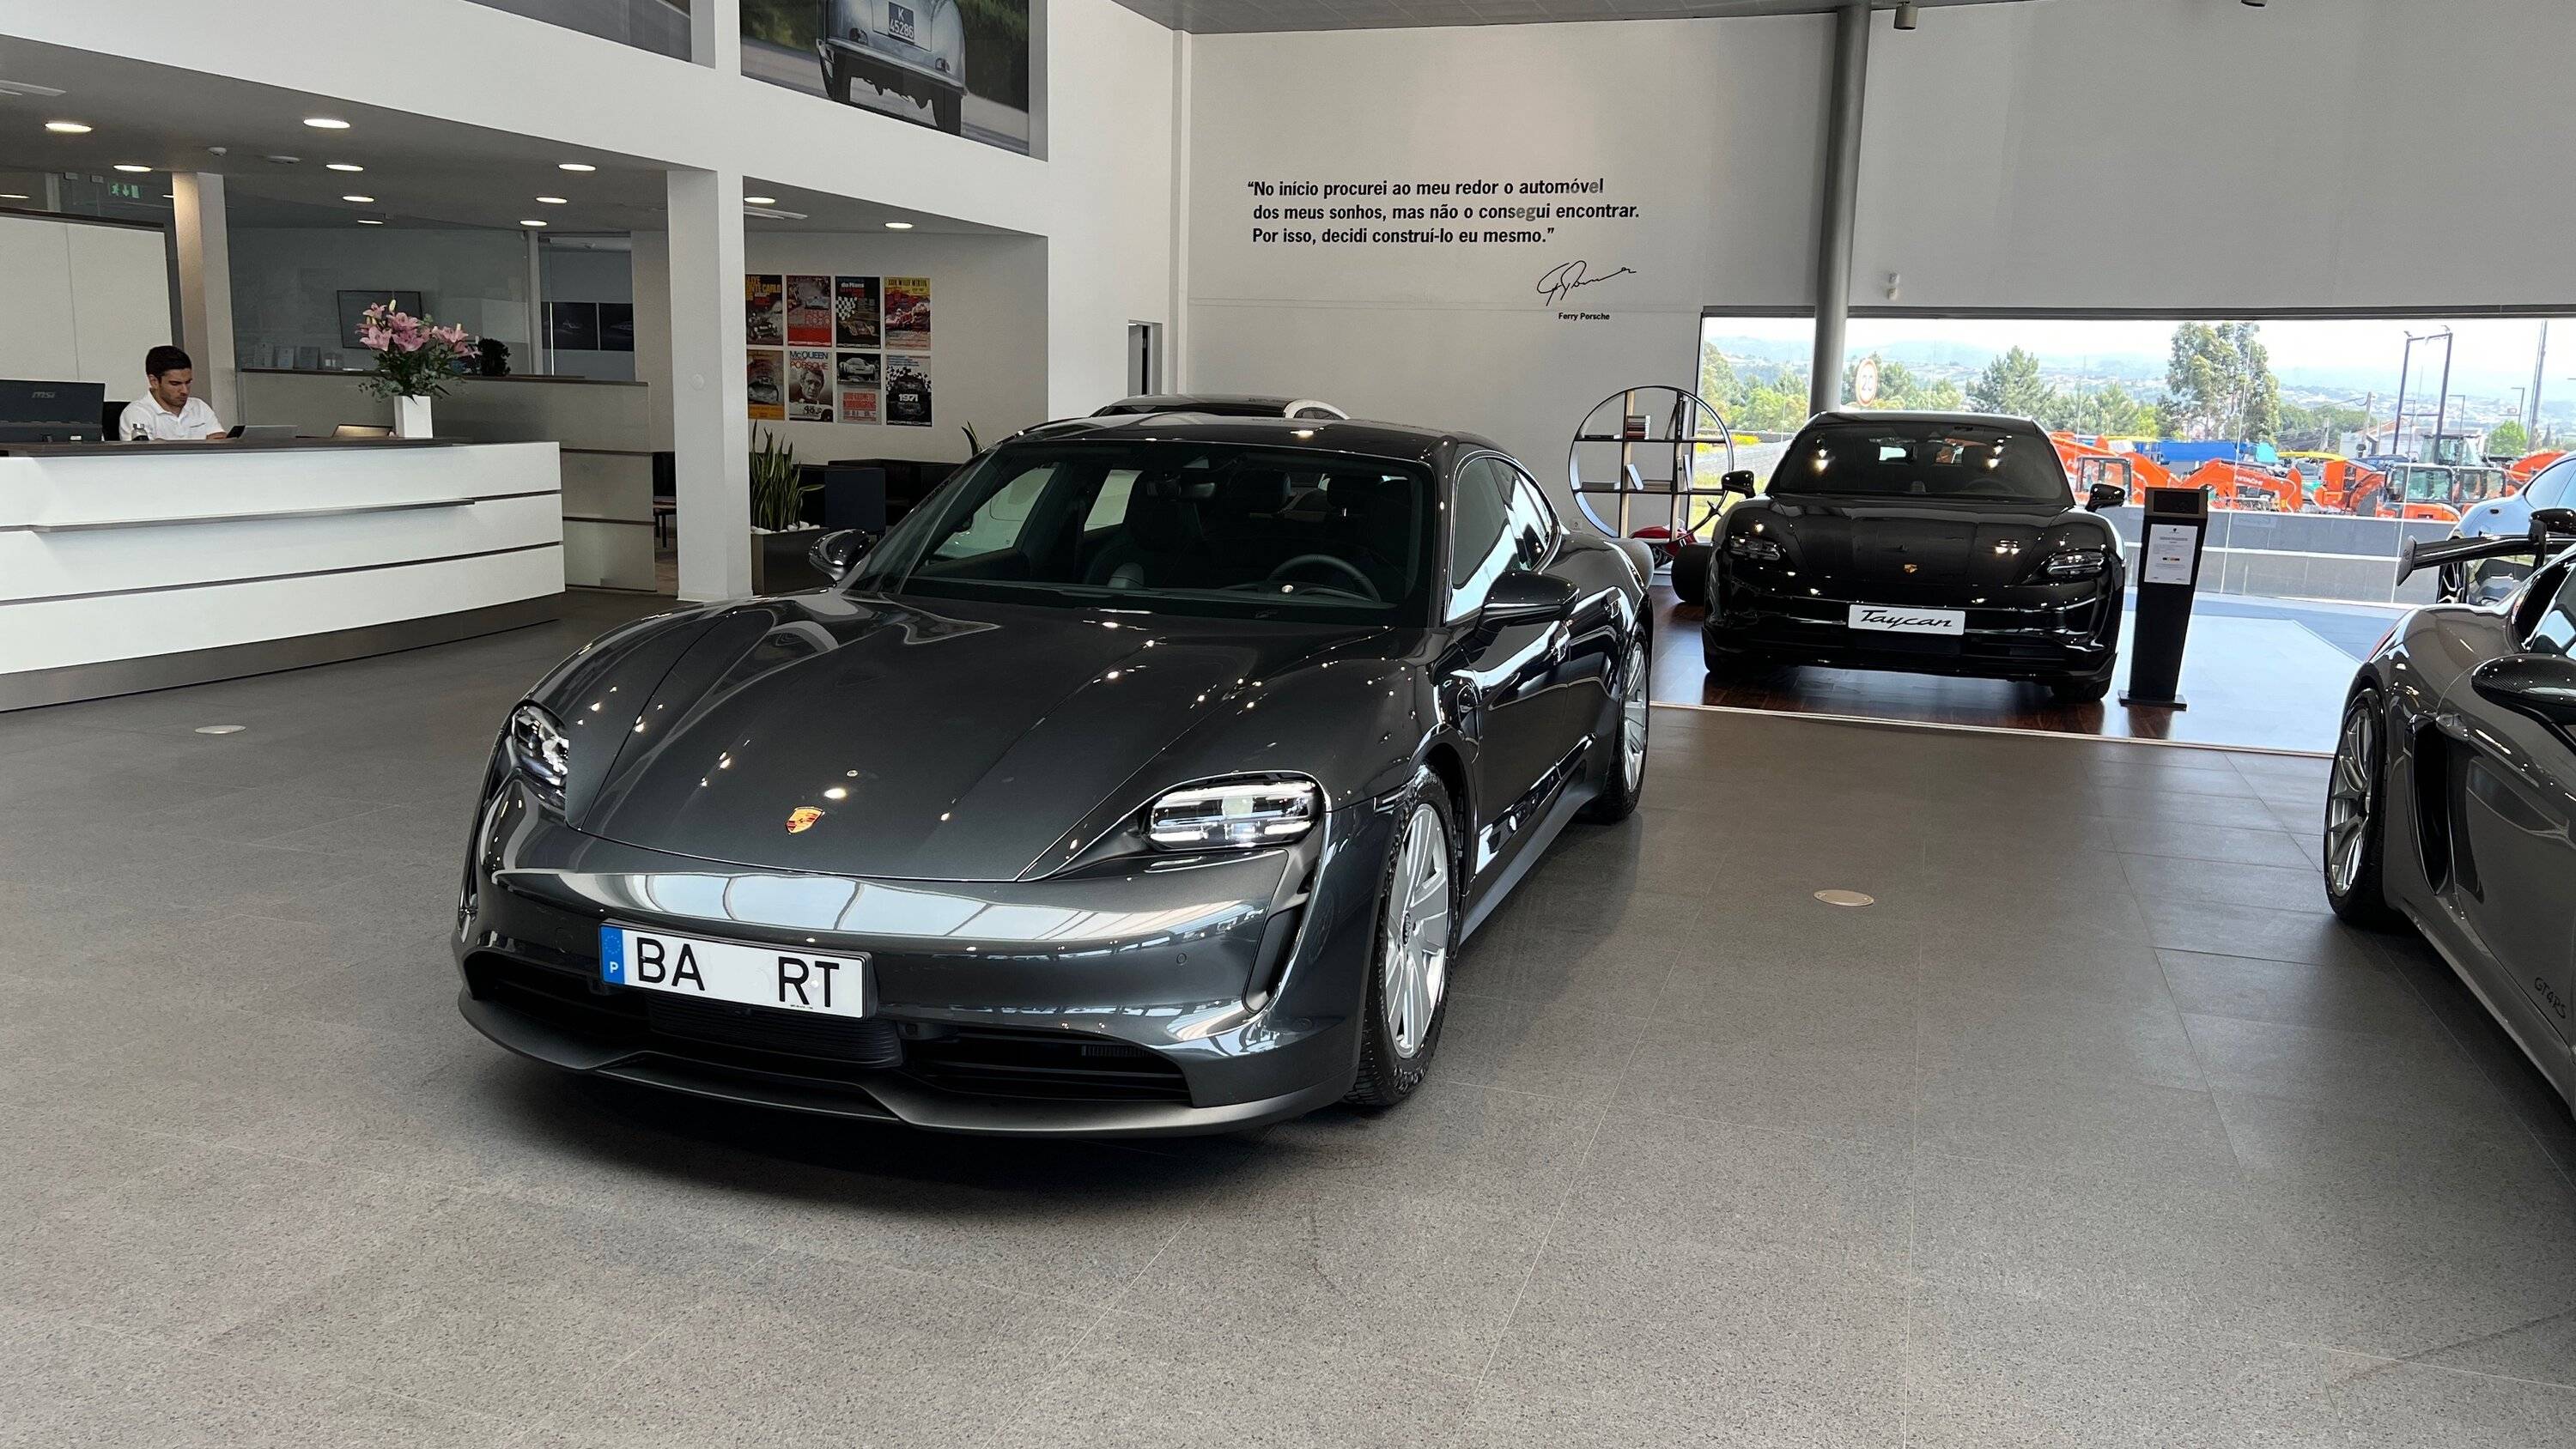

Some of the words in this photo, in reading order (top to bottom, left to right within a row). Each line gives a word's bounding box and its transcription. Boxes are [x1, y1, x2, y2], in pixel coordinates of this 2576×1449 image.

[898, 7, 904, 21] K
[890, 18, 914, 38] 45286
[1279, 180, 1318, 196] início
[1324, 180, 1387, 199] procurei
[1393, 184, 1411, 196] ao
[1417, 184, 1450, 196] meu
[1455, 179, 1499, 196] redor
[1504, 183, 1514, 195] o
[1519, 178, 1604, 195] automóvel
[1253, 204, 1279, 220] dos
[1285, 206, 1325, 220] meus
[1329, 204, 1387, 222] sonhos,
[1393, 207, 1425, 220] mas
[1430, 203, 1459, 220] não
[1464, 207, 1473, 220] o
[1479, 203, 1551, 221] consegui
[1556, 203, 1639, 219] encontrar.
[1253, 227, 1279, 243] Por
[1283, 227, 1316, 246] isso,
[1321, 227, 1368, 244] decidi
[1372, 227, 1454, 245] construí-lo
[1459, 231, 1479, 244] eu
[1484, 227, 1554, 243] mesmo.”
[1558, 312, 1578, 321] Ferry
[898, 393, 919, 402] 1971
[1861, 609, 1953, 628] Taycan
[610, 961, 619, 974] P
[636, 937, 705, 991] BA
[778, 955, 841, 1008] RT
